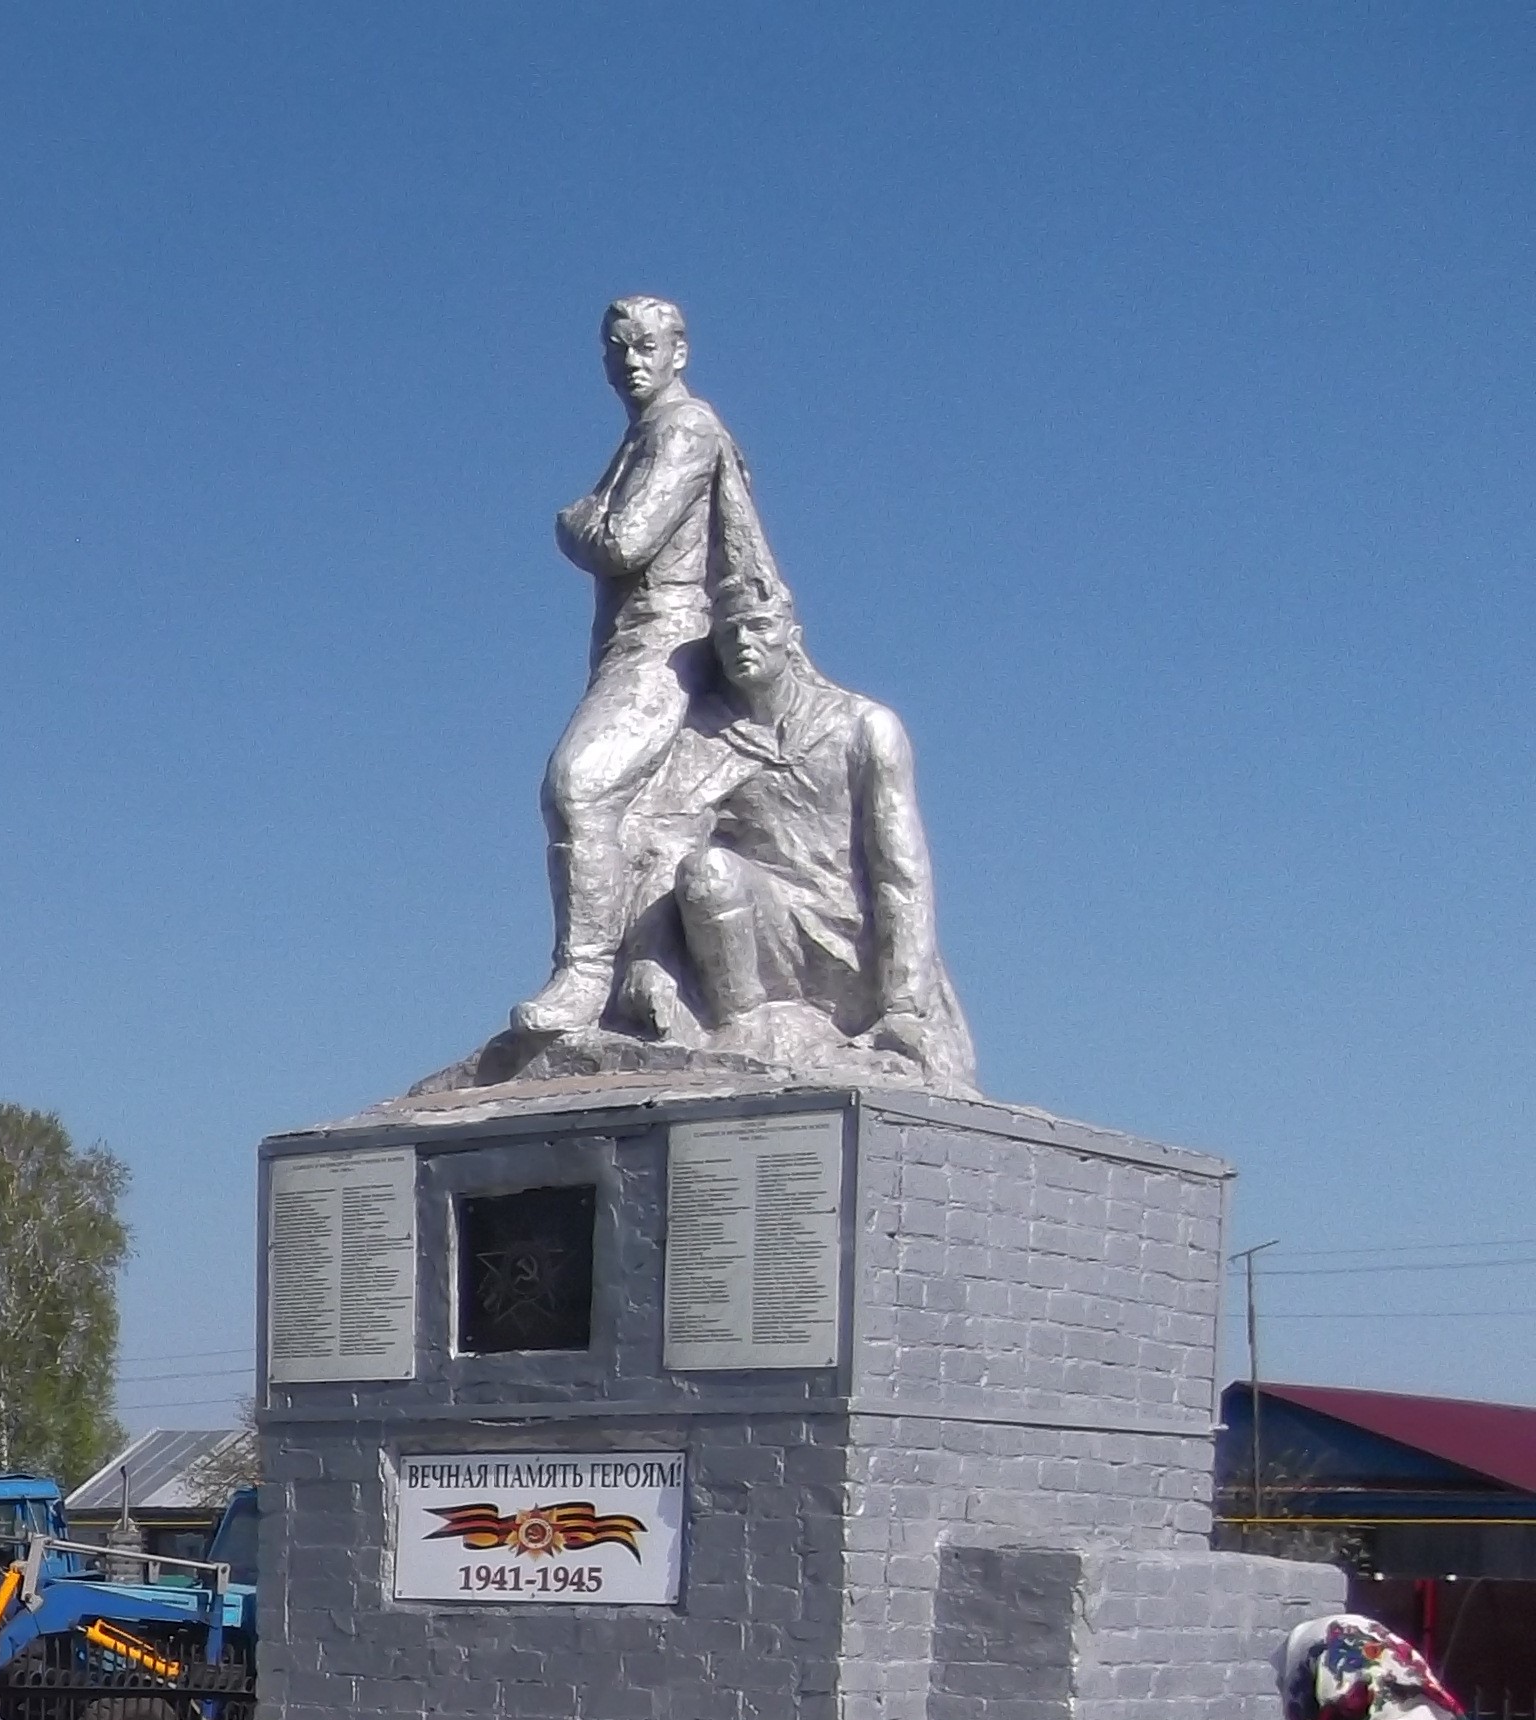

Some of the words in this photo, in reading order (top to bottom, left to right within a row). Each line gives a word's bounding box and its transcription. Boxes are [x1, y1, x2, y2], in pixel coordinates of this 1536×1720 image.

[408, 1463, 490, 1489] ВЕЧНАЯ
[493, 1462, 584, 1489] ПАМЯТЬ
[588, 1462, 683, 1489] ГЕРОЯМ!
[458, 1564, 604, 1593] 1941-1945
